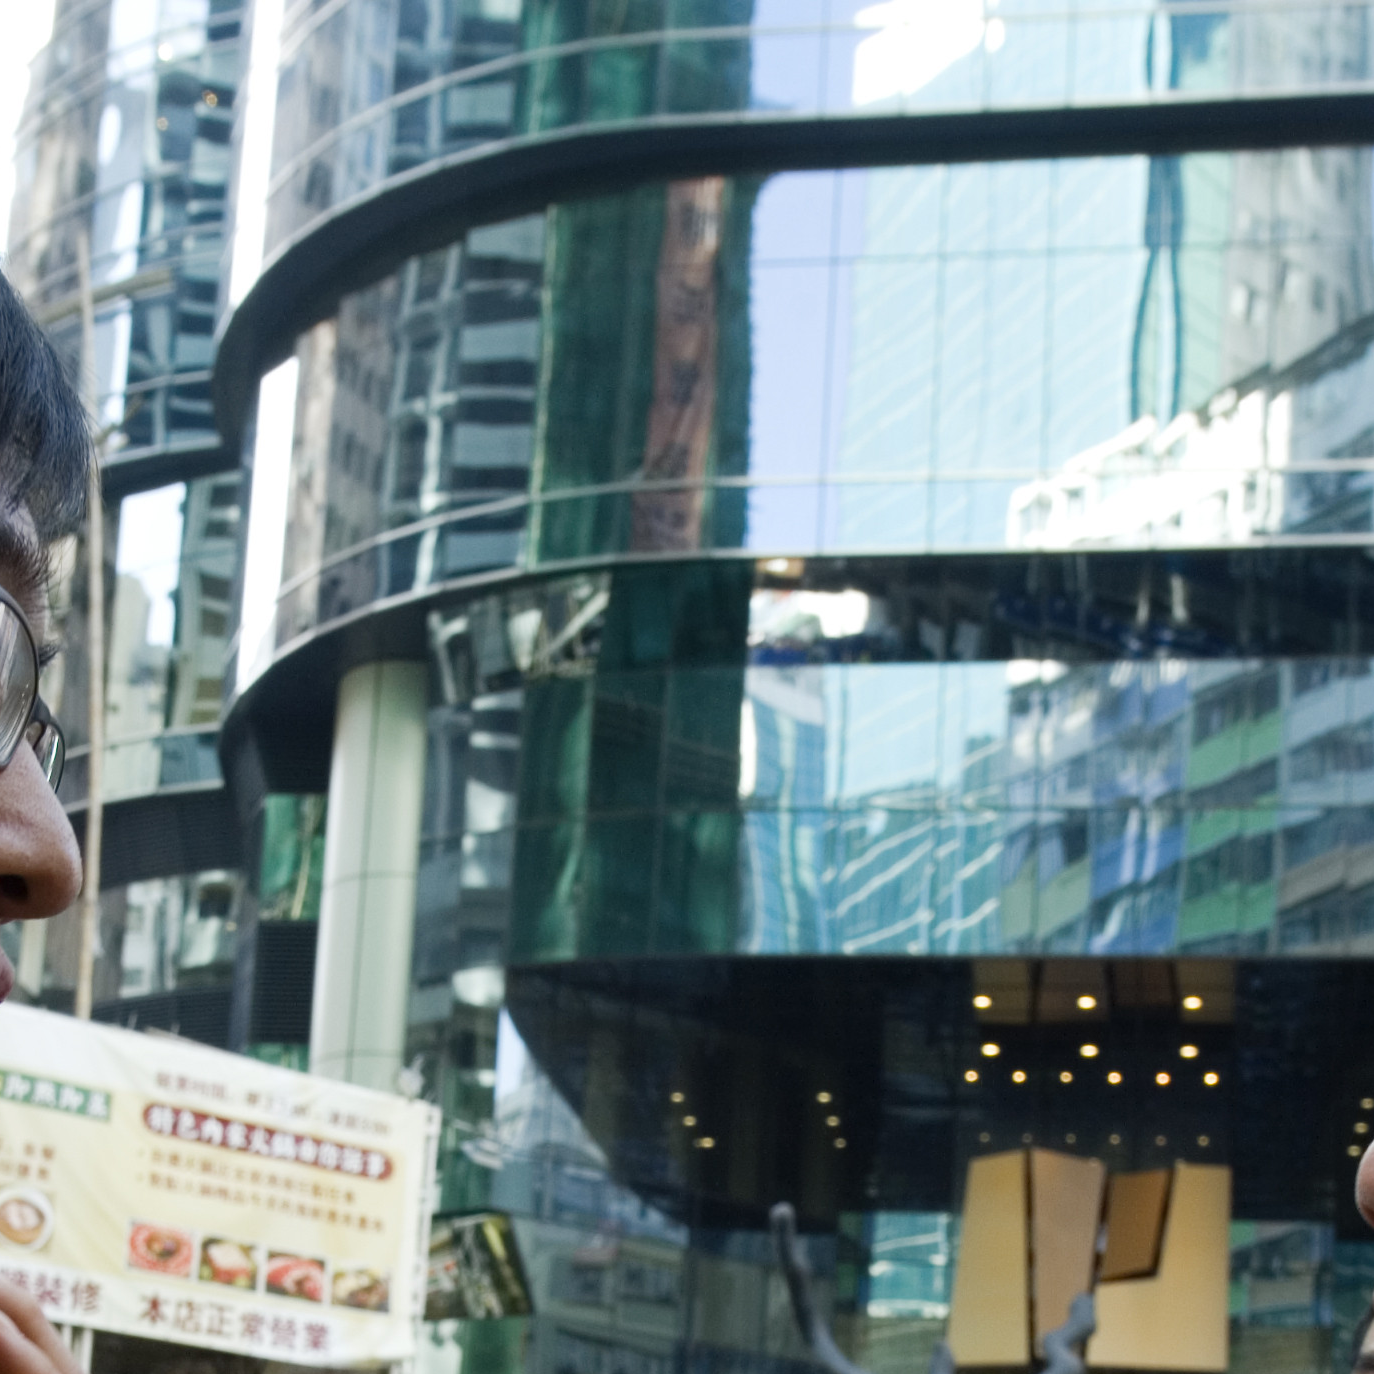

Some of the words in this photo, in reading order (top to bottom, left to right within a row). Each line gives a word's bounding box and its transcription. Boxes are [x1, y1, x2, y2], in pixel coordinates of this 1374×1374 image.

[139, 1291, 331, 1351] 本店正常營業
